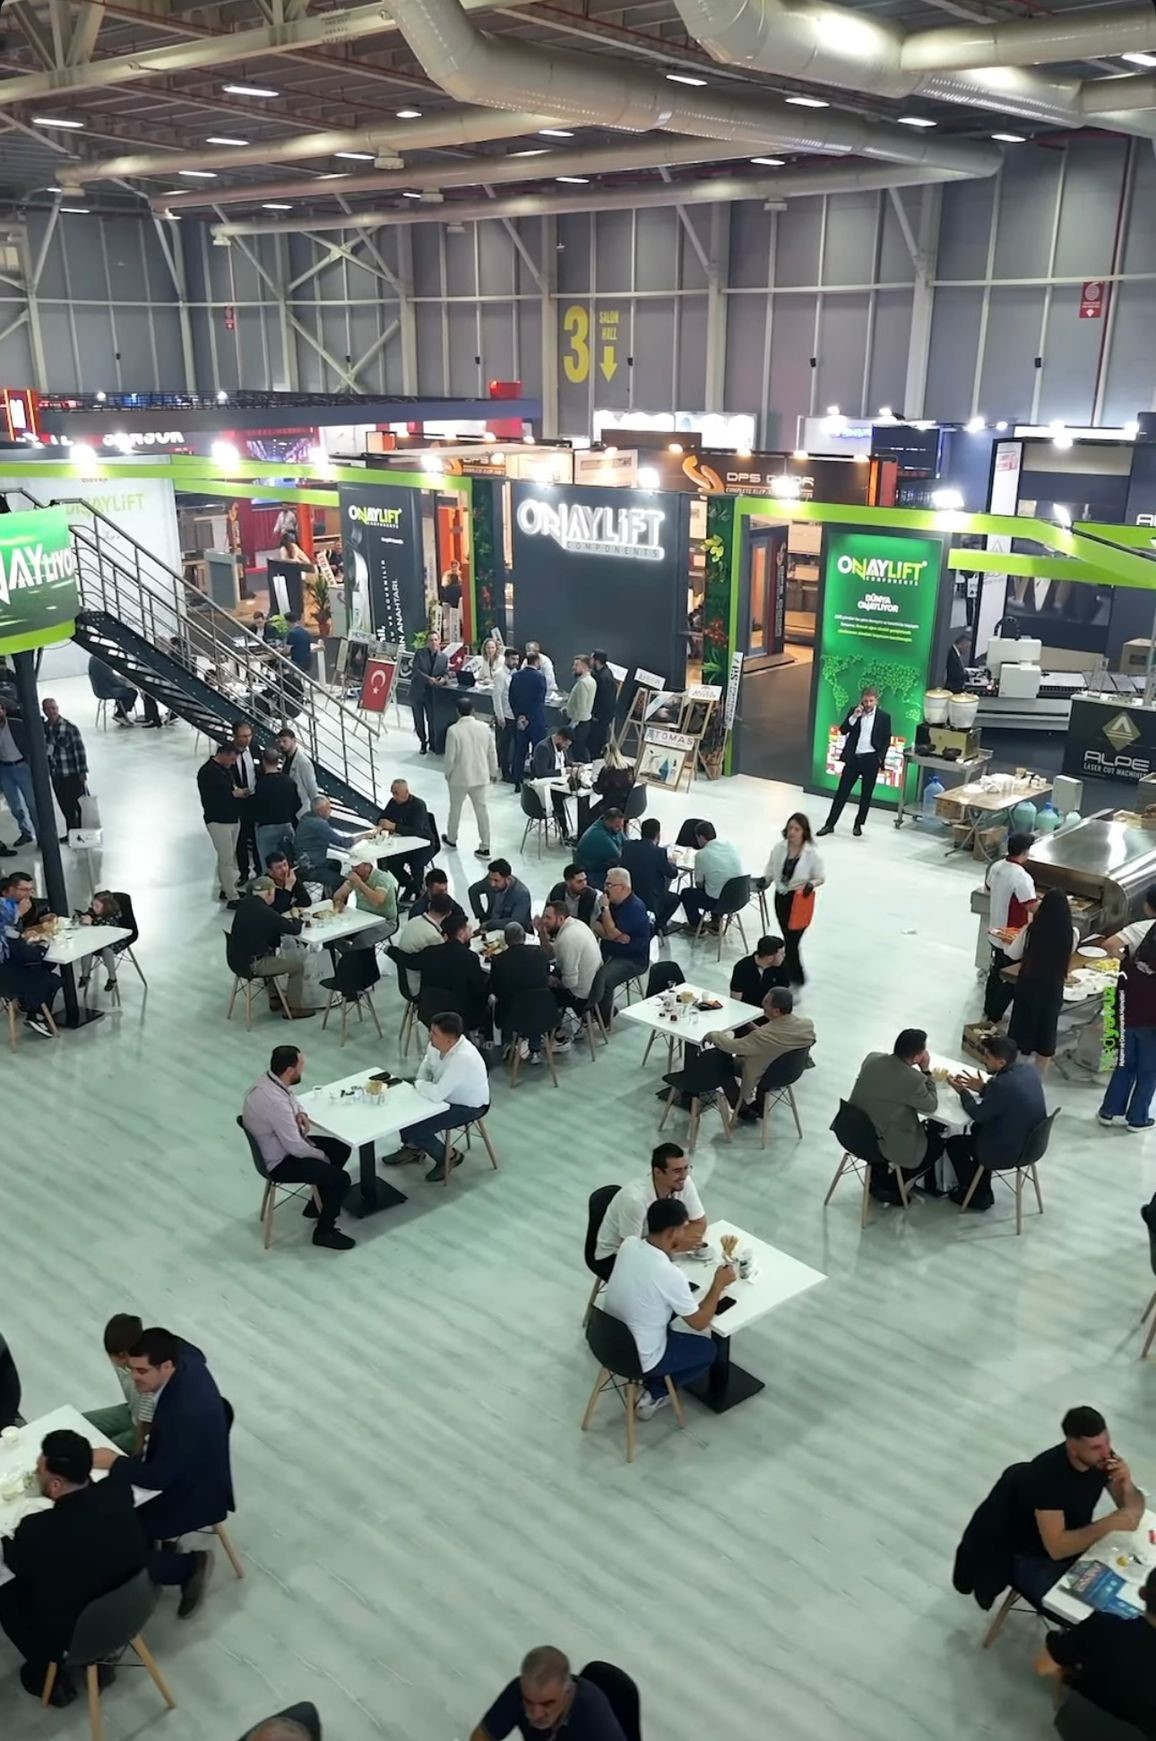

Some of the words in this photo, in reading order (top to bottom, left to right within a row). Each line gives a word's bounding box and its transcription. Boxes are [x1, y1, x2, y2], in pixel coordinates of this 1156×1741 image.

[599, 310, 619, 324] SALON
[601, 327, 617, 340] HALL
[563, 305, 589, 384] 3
[726, 471, 761, 483] DPS
[348, 505, 401, 525] ONAYLIFT
[517, 498, 665, 549] ONAYLIFT
[566, 541, 660, 559] COMPONENTS
[837, 555, 923, 581] ONAYLIFT
[865, 592, 891, 604] DÜNYA
[1084, 751, 1150, 772] ALPE
[1084, 763, 1102, 772] LASER
[1103, 766, 1116, 775] CUT
